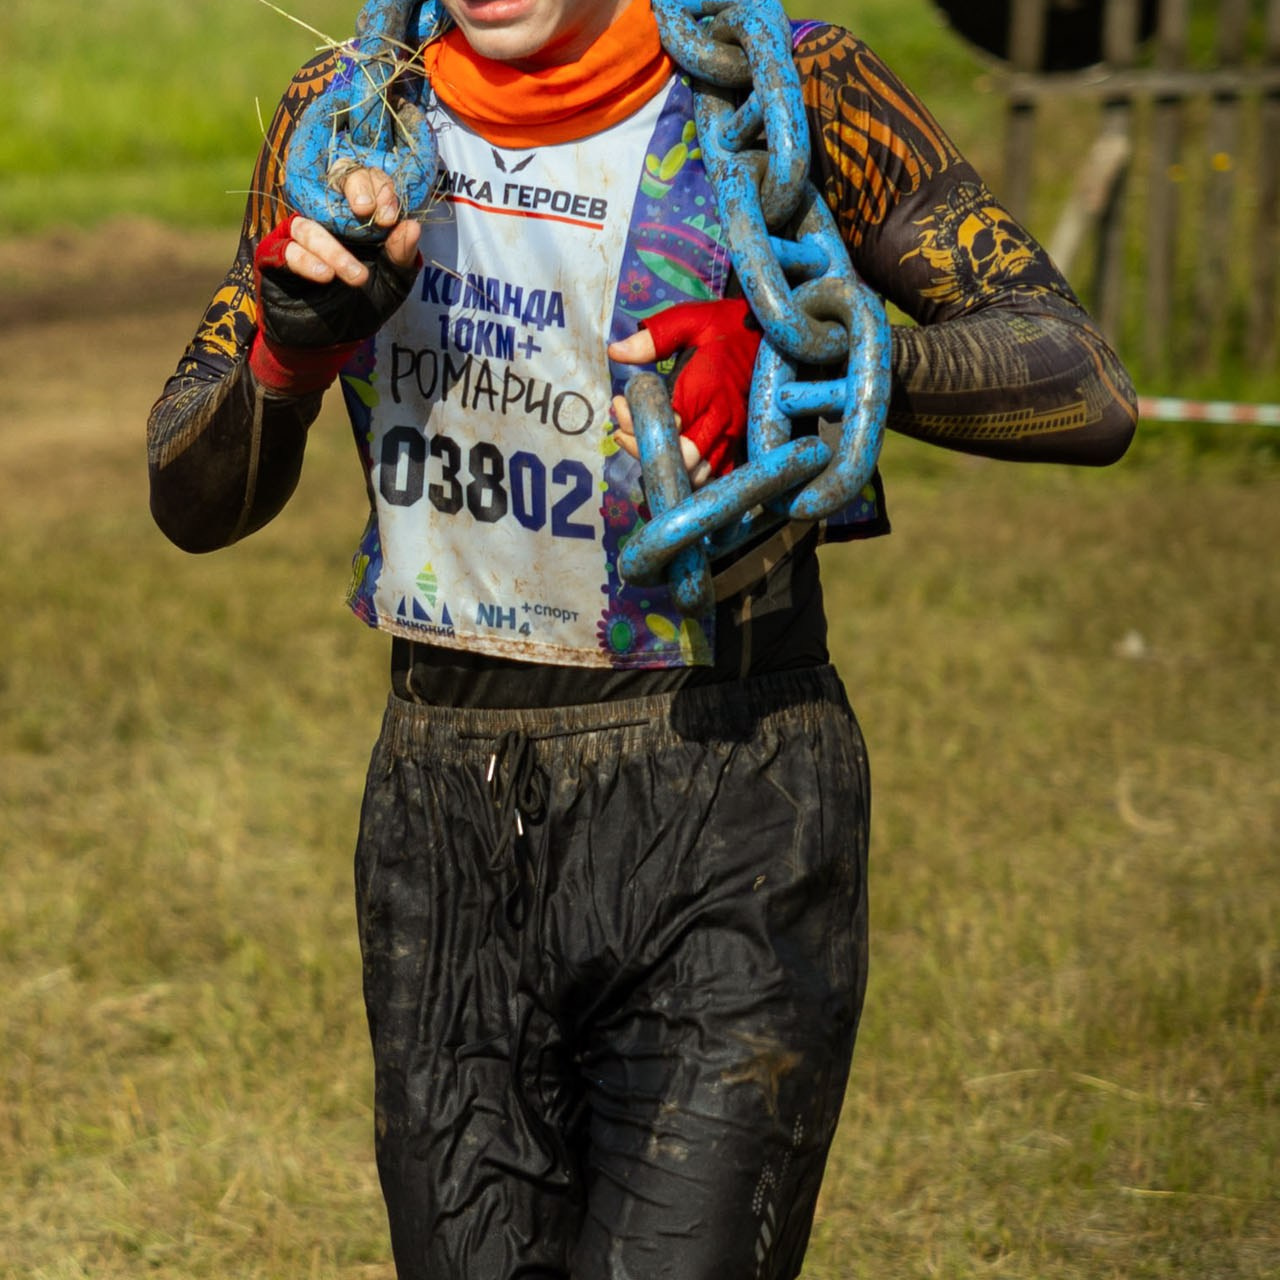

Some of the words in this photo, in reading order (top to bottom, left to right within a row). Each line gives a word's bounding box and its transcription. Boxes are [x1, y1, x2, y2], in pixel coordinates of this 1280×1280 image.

[435, 169, 494, 203] ОНКА
[503, 183, 608, 221] ГЕРОЕВ
[421, 266, 565, 331] КОМАНДА
[438, 314, 542, 361] 10КМ+
[390, 342, 595, 436] РОМАРИО
[379, 425, 596, 540] 03802
